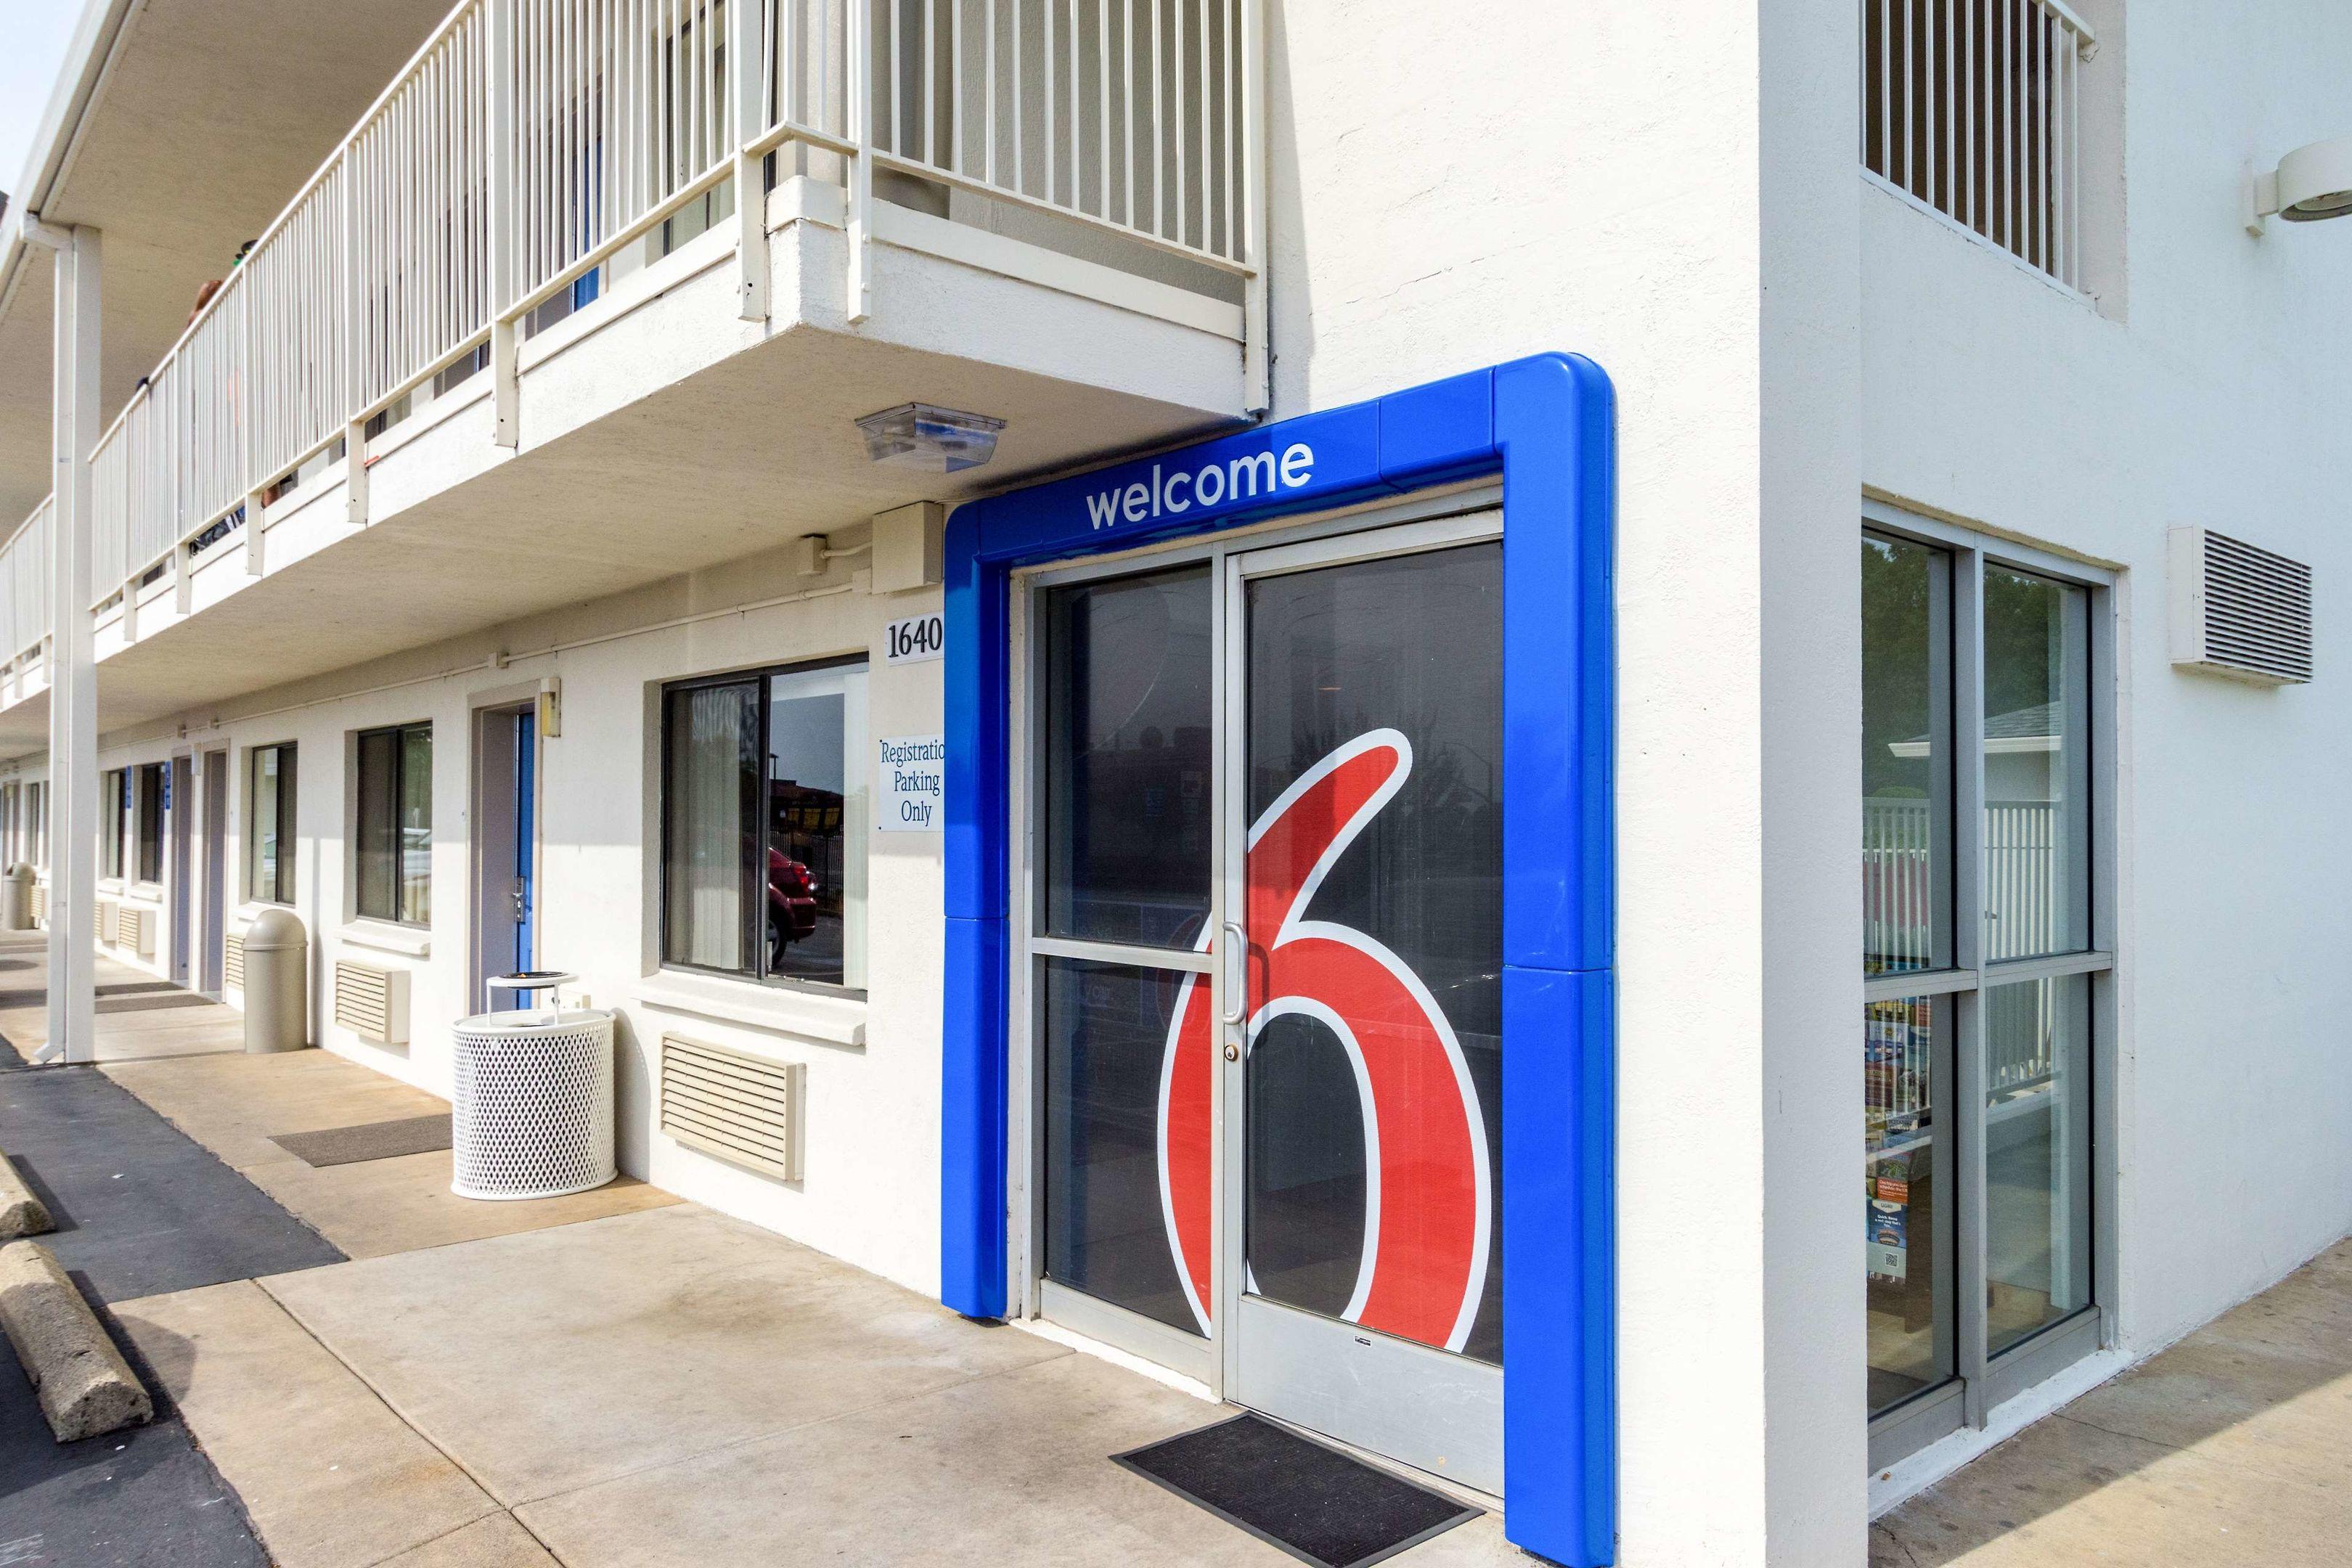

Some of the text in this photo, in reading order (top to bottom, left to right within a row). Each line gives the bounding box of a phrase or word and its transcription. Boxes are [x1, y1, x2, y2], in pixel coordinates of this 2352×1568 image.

[1087, 443, 1314, 530] welcome
[888, 617, 943, 658] 1640
[881, 739, 944, 767] Registratio
[894, 770, 940, 796] Parking
[901, 800, 932, 827] Only
[1157, 727, 1492, 1355] 6
